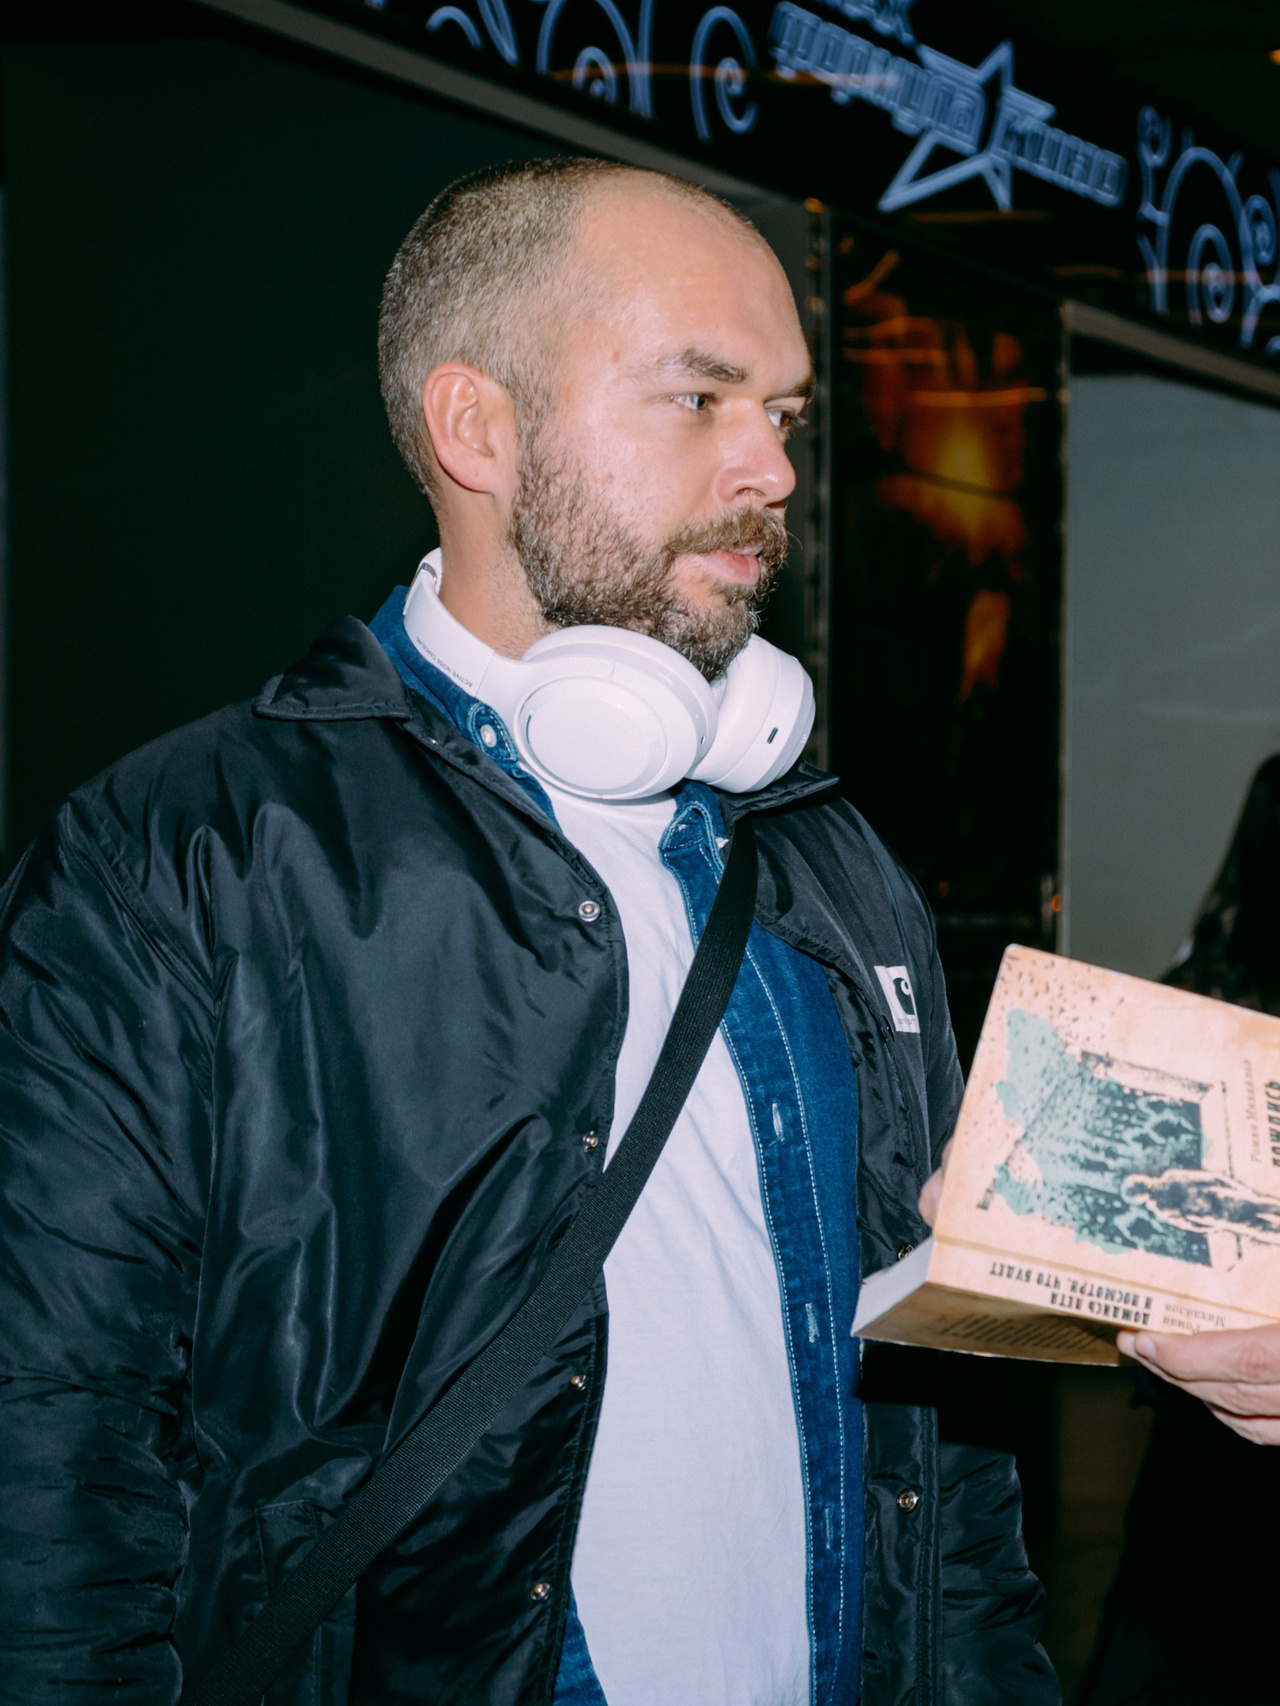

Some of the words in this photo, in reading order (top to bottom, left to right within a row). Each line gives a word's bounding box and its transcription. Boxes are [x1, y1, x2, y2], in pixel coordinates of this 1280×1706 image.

[436, 657, 452, 673] NOISE
[452, 670, 473, 688] ACTIVE
[989, 1261, 1032, 1284] БУДЕТ
[1036, 1271, 1062, 1291] ЧТО
[1050, 1291, 1083, 1311] ЛЕТА
[1144, 1296, 1153, 1310] И
[1088, 1301, 1151, 1326] ДОЖДИСЬ
